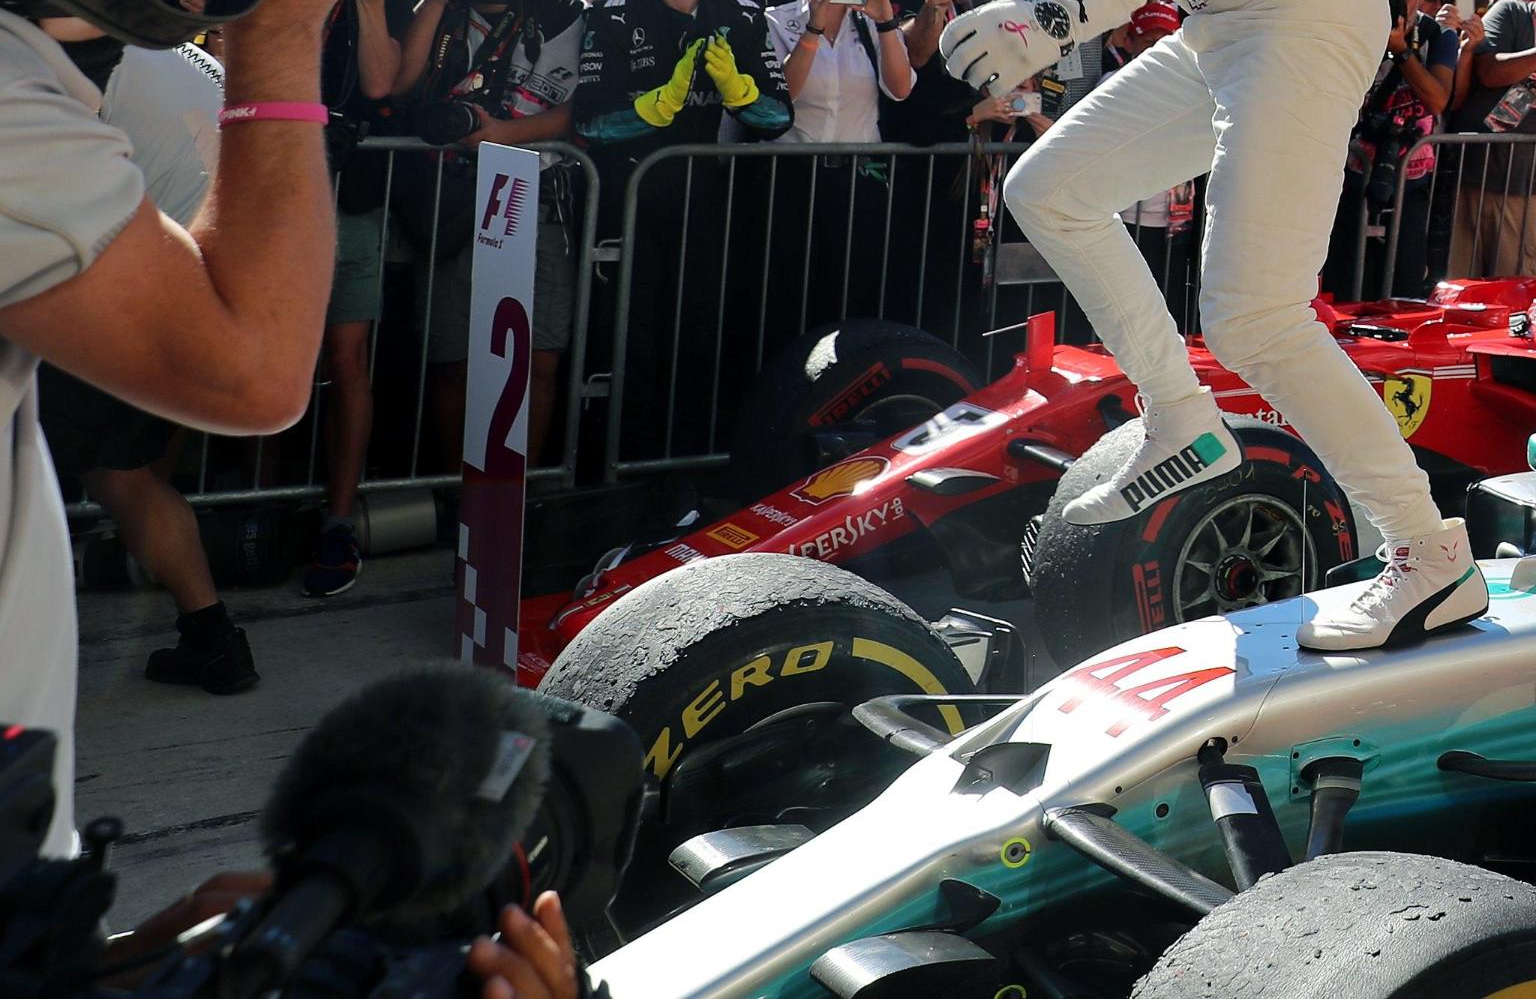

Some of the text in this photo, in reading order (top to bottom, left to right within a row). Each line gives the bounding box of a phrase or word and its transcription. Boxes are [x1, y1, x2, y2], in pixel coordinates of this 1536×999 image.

[484, 295, 531, 471] 2
[1120, 444, 1208, 513] PUMA
[716, 527, 751, 545] PIRELLI
[643, 640, 835, 780] ZERO
[1057, 645, 1237, 739] 44
